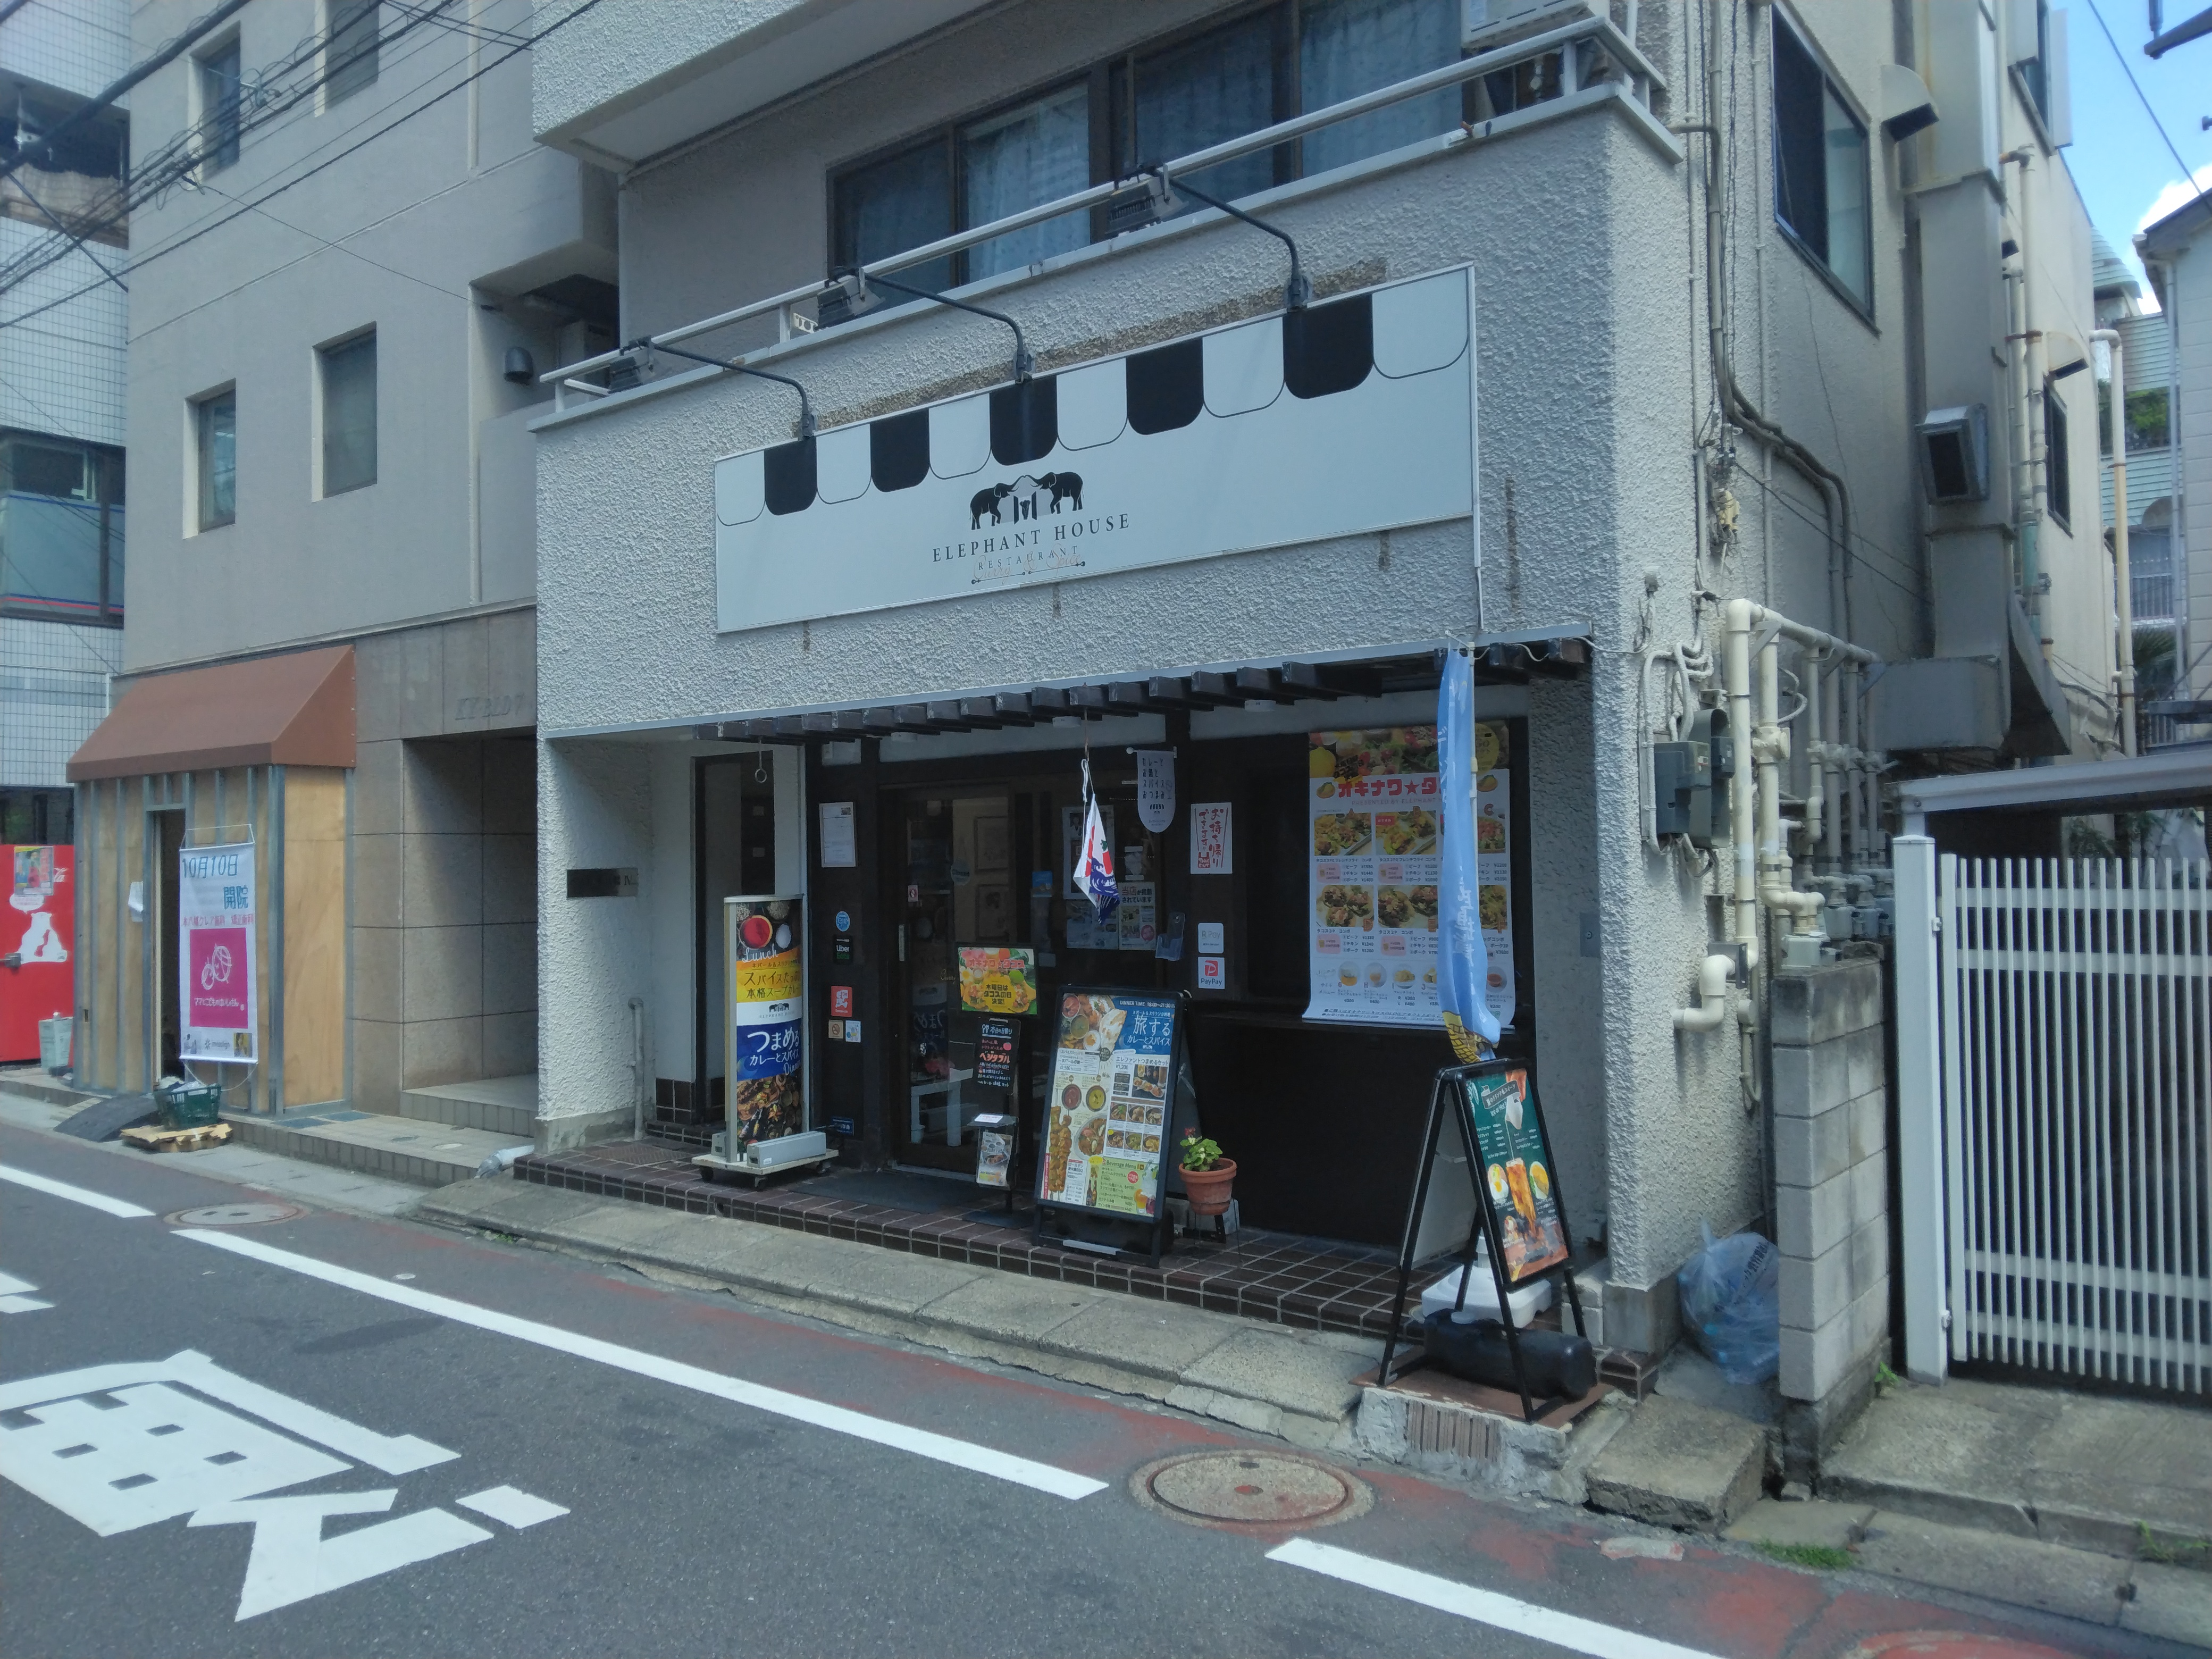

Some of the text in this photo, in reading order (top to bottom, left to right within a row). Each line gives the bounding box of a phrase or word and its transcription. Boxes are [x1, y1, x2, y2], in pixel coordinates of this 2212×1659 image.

[933, 513, 1130, 562] ELEPHANT HOUSE
[978, 546, 1078, 571] RESTAURANT
[1484, 803, 1494, 816] C
[182, 853, 238, 879] 10月10日
[223, 885, 249, 910] 開院
[742, 943, 780, 963] Lunch
[1201, 977, 1222, 986] PayPay
[1133, 1014, 1170, 1036] 旅する
[747, 1026, 800, 1052] つまめる
[1127, 1034, 1170, 1046] カレーとスパイス
[750, 1049, 799, 1066] カレーとスパイス
[1116, 1057, 1168, 1066] エレファントつまめるセット
[1106, 1160, 1125, 1168] Beverage
